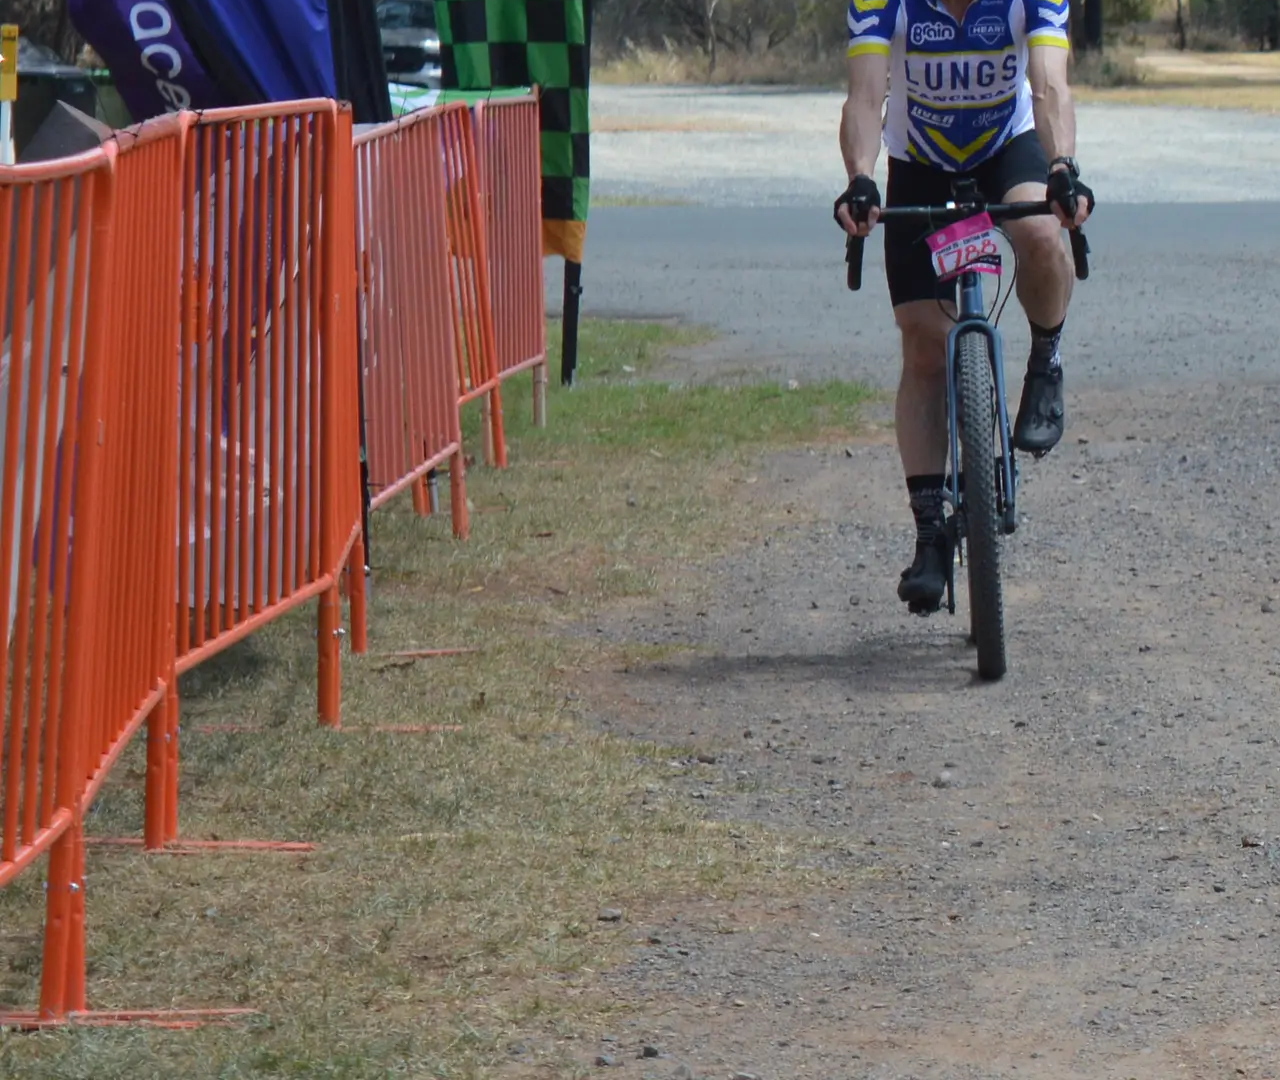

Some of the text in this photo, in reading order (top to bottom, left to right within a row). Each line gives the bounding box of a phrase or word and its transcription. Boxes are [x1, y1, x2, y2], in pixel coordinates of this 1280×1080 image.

[911, 22, 955, 45] Brain
[973, 25, 1005, 34] HEART
[905, 54, 1017, 91] LUNGS
